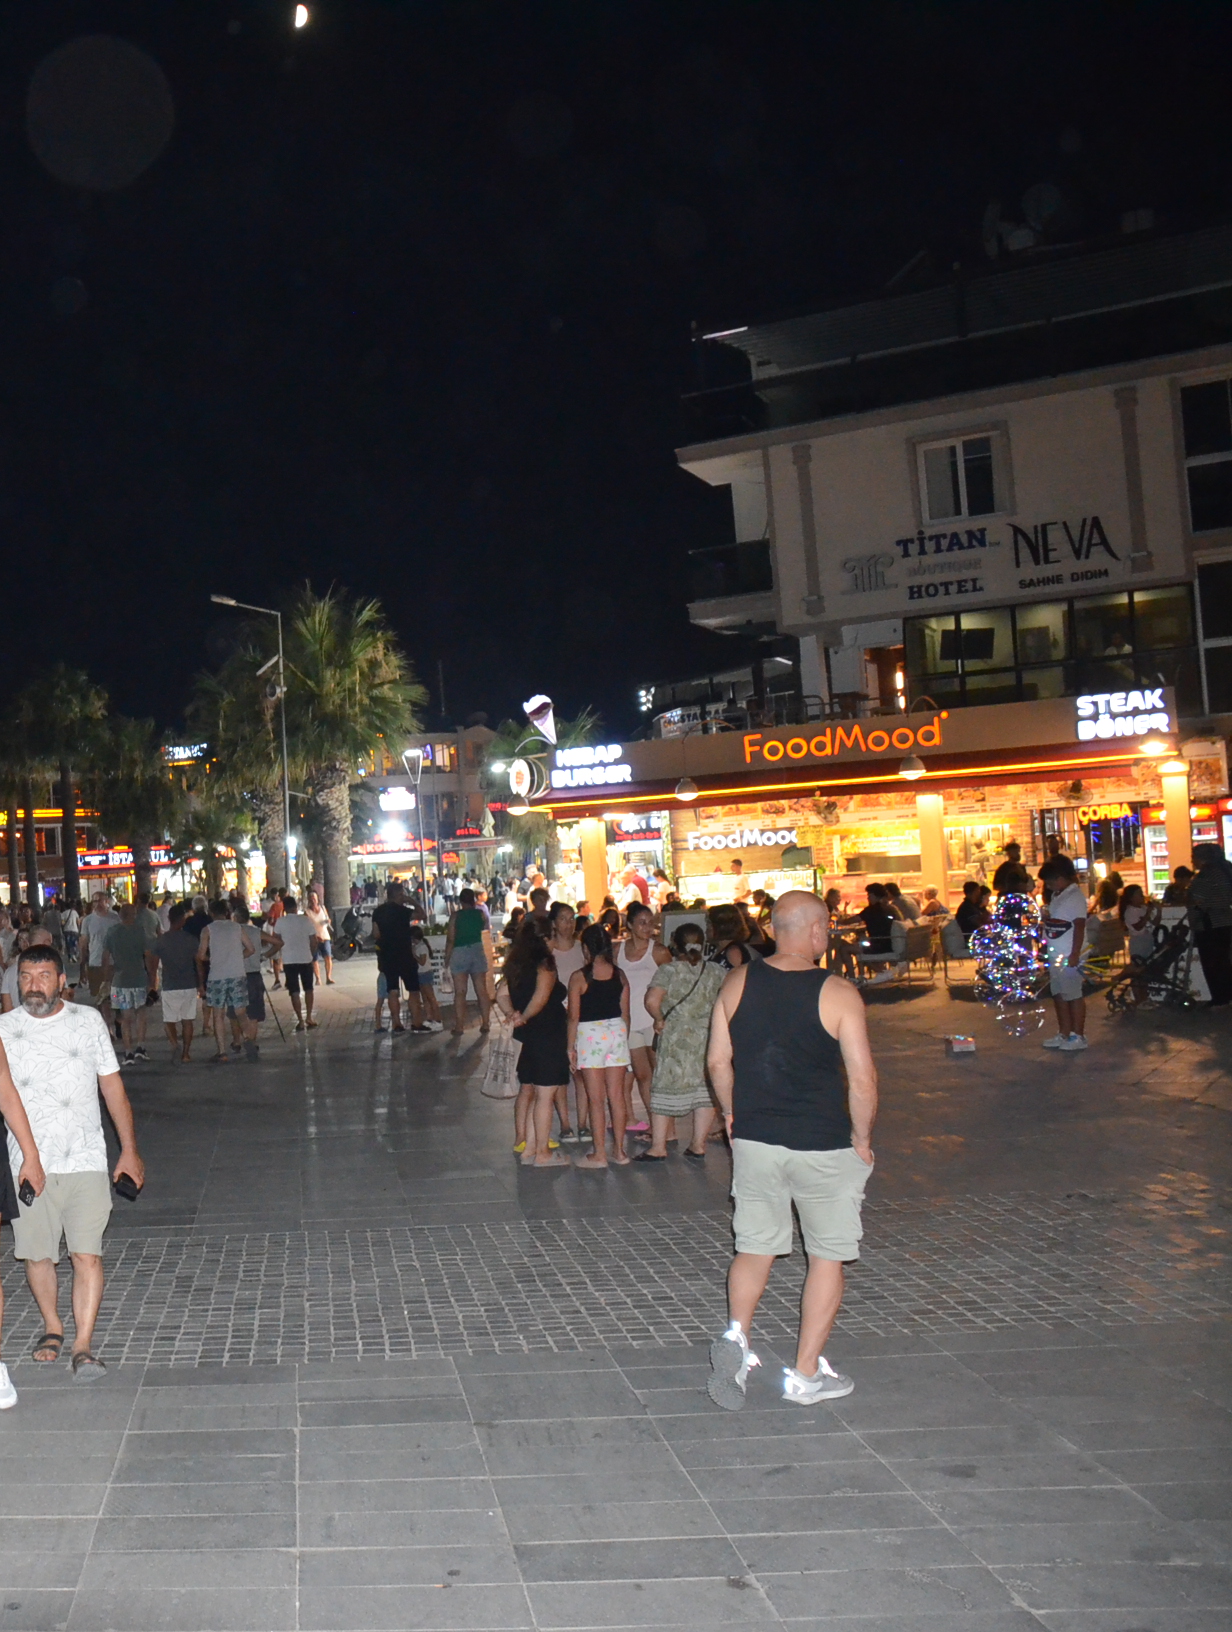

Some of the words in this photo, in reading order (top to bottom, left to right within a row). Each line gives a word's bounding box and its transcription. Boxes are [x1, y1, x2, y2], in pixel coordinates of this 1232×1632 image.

[896, 527, 987, 558] TİTAN
[1007, 516, 1121, 568] NEVA
[908, 577, 984, 600] HOTEL
[1019, 574, 1064, 589] SAHNE
[1076, 688, 1165, 717] STEAK
[743, 714, 944, 763] FoodMood
[1077, 712, 1170, 741] DÖNER
[556, 744, 623, 767] KEBAP
[551, 764, 632, 788] BURGER
[1078, 803, 1133, 825] ÇORBA
